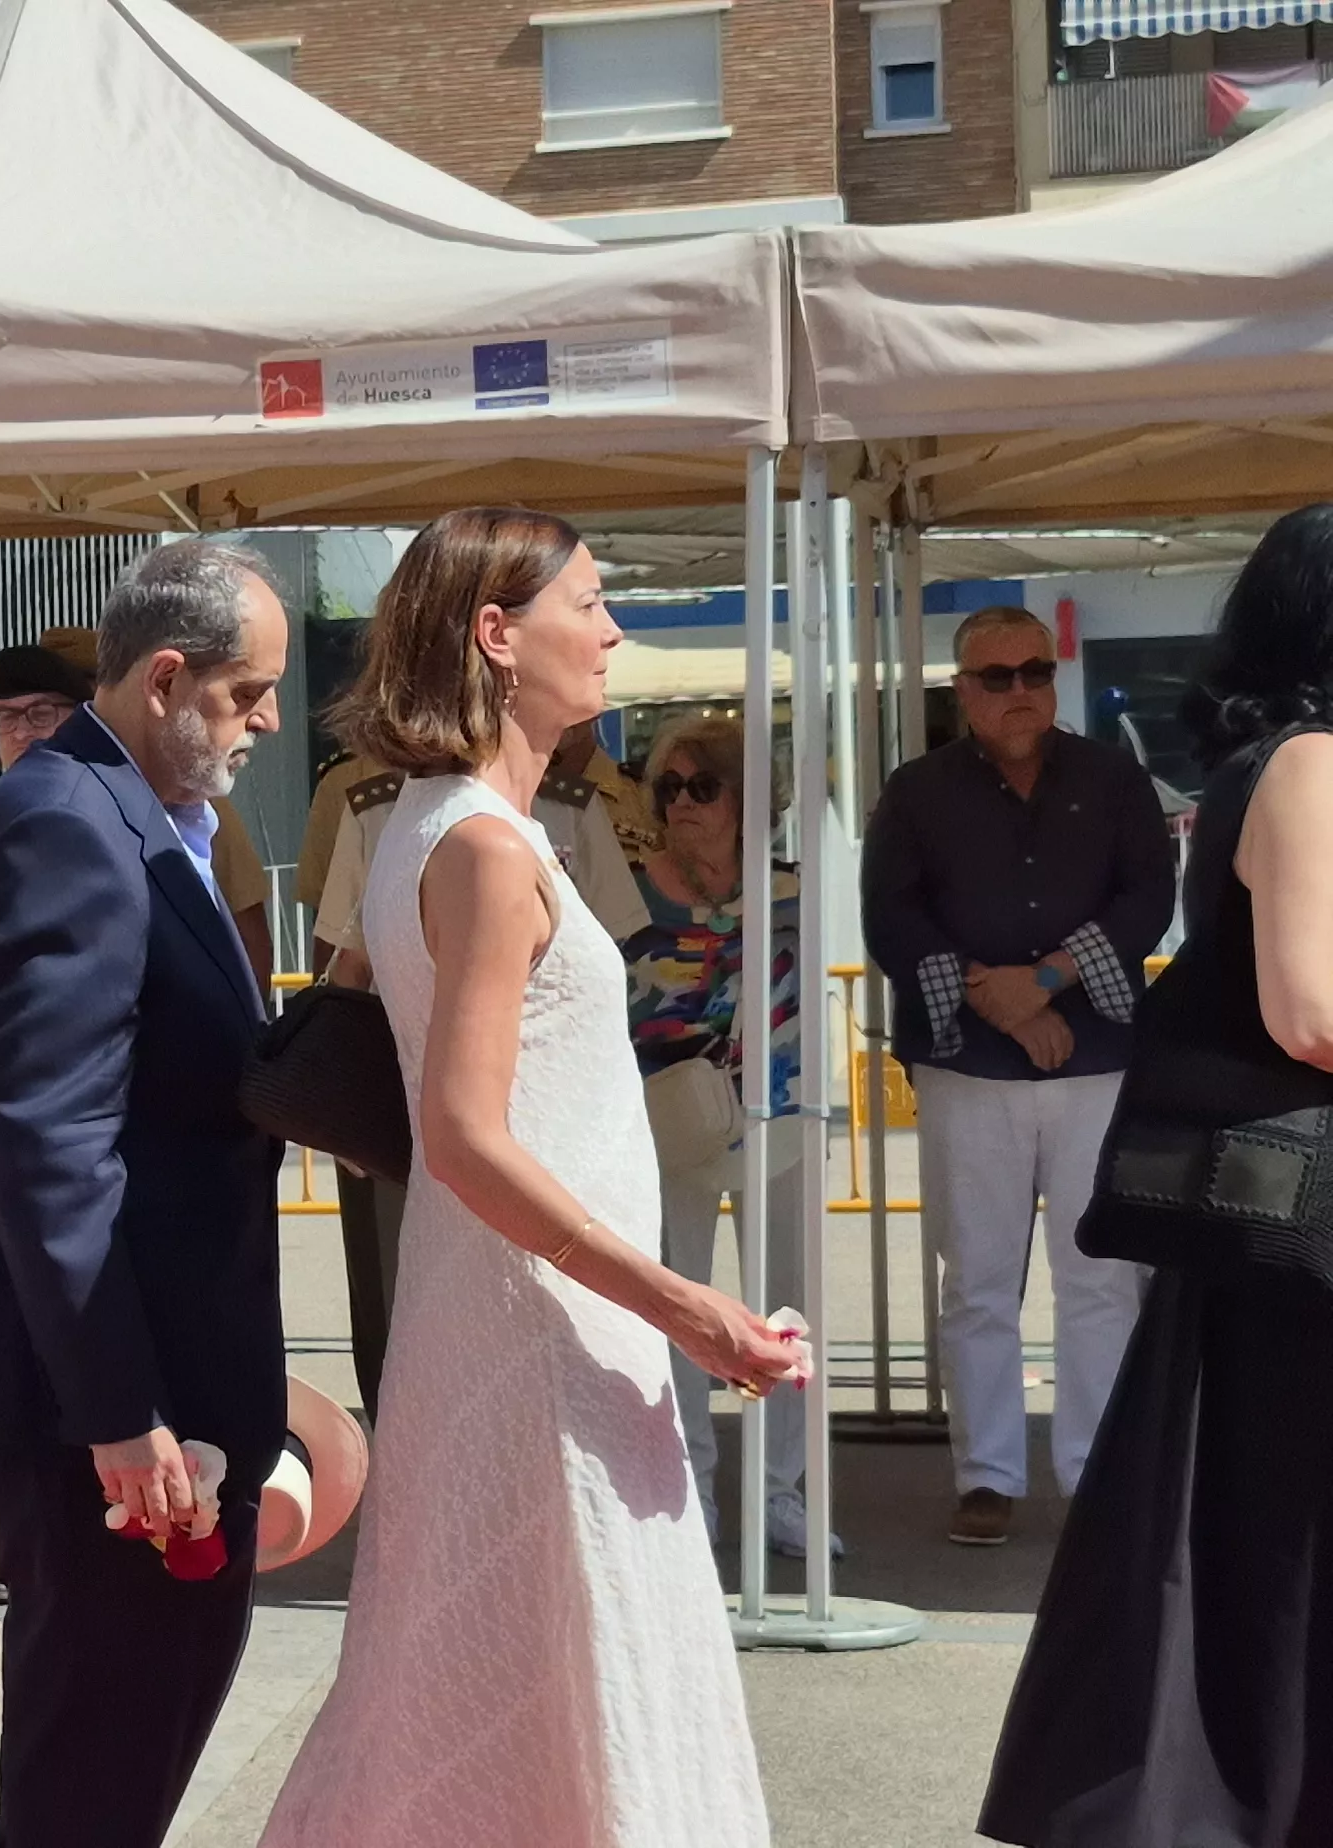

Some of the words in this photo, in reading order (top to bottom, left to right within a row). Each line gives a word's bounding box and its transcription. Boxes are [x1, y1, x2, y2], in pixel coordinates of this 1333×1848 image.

[335, 364, 461, 389] Ayuntamiento
[336, 389, 358, 405] de
[364, 387, 432, 405] Huesca
